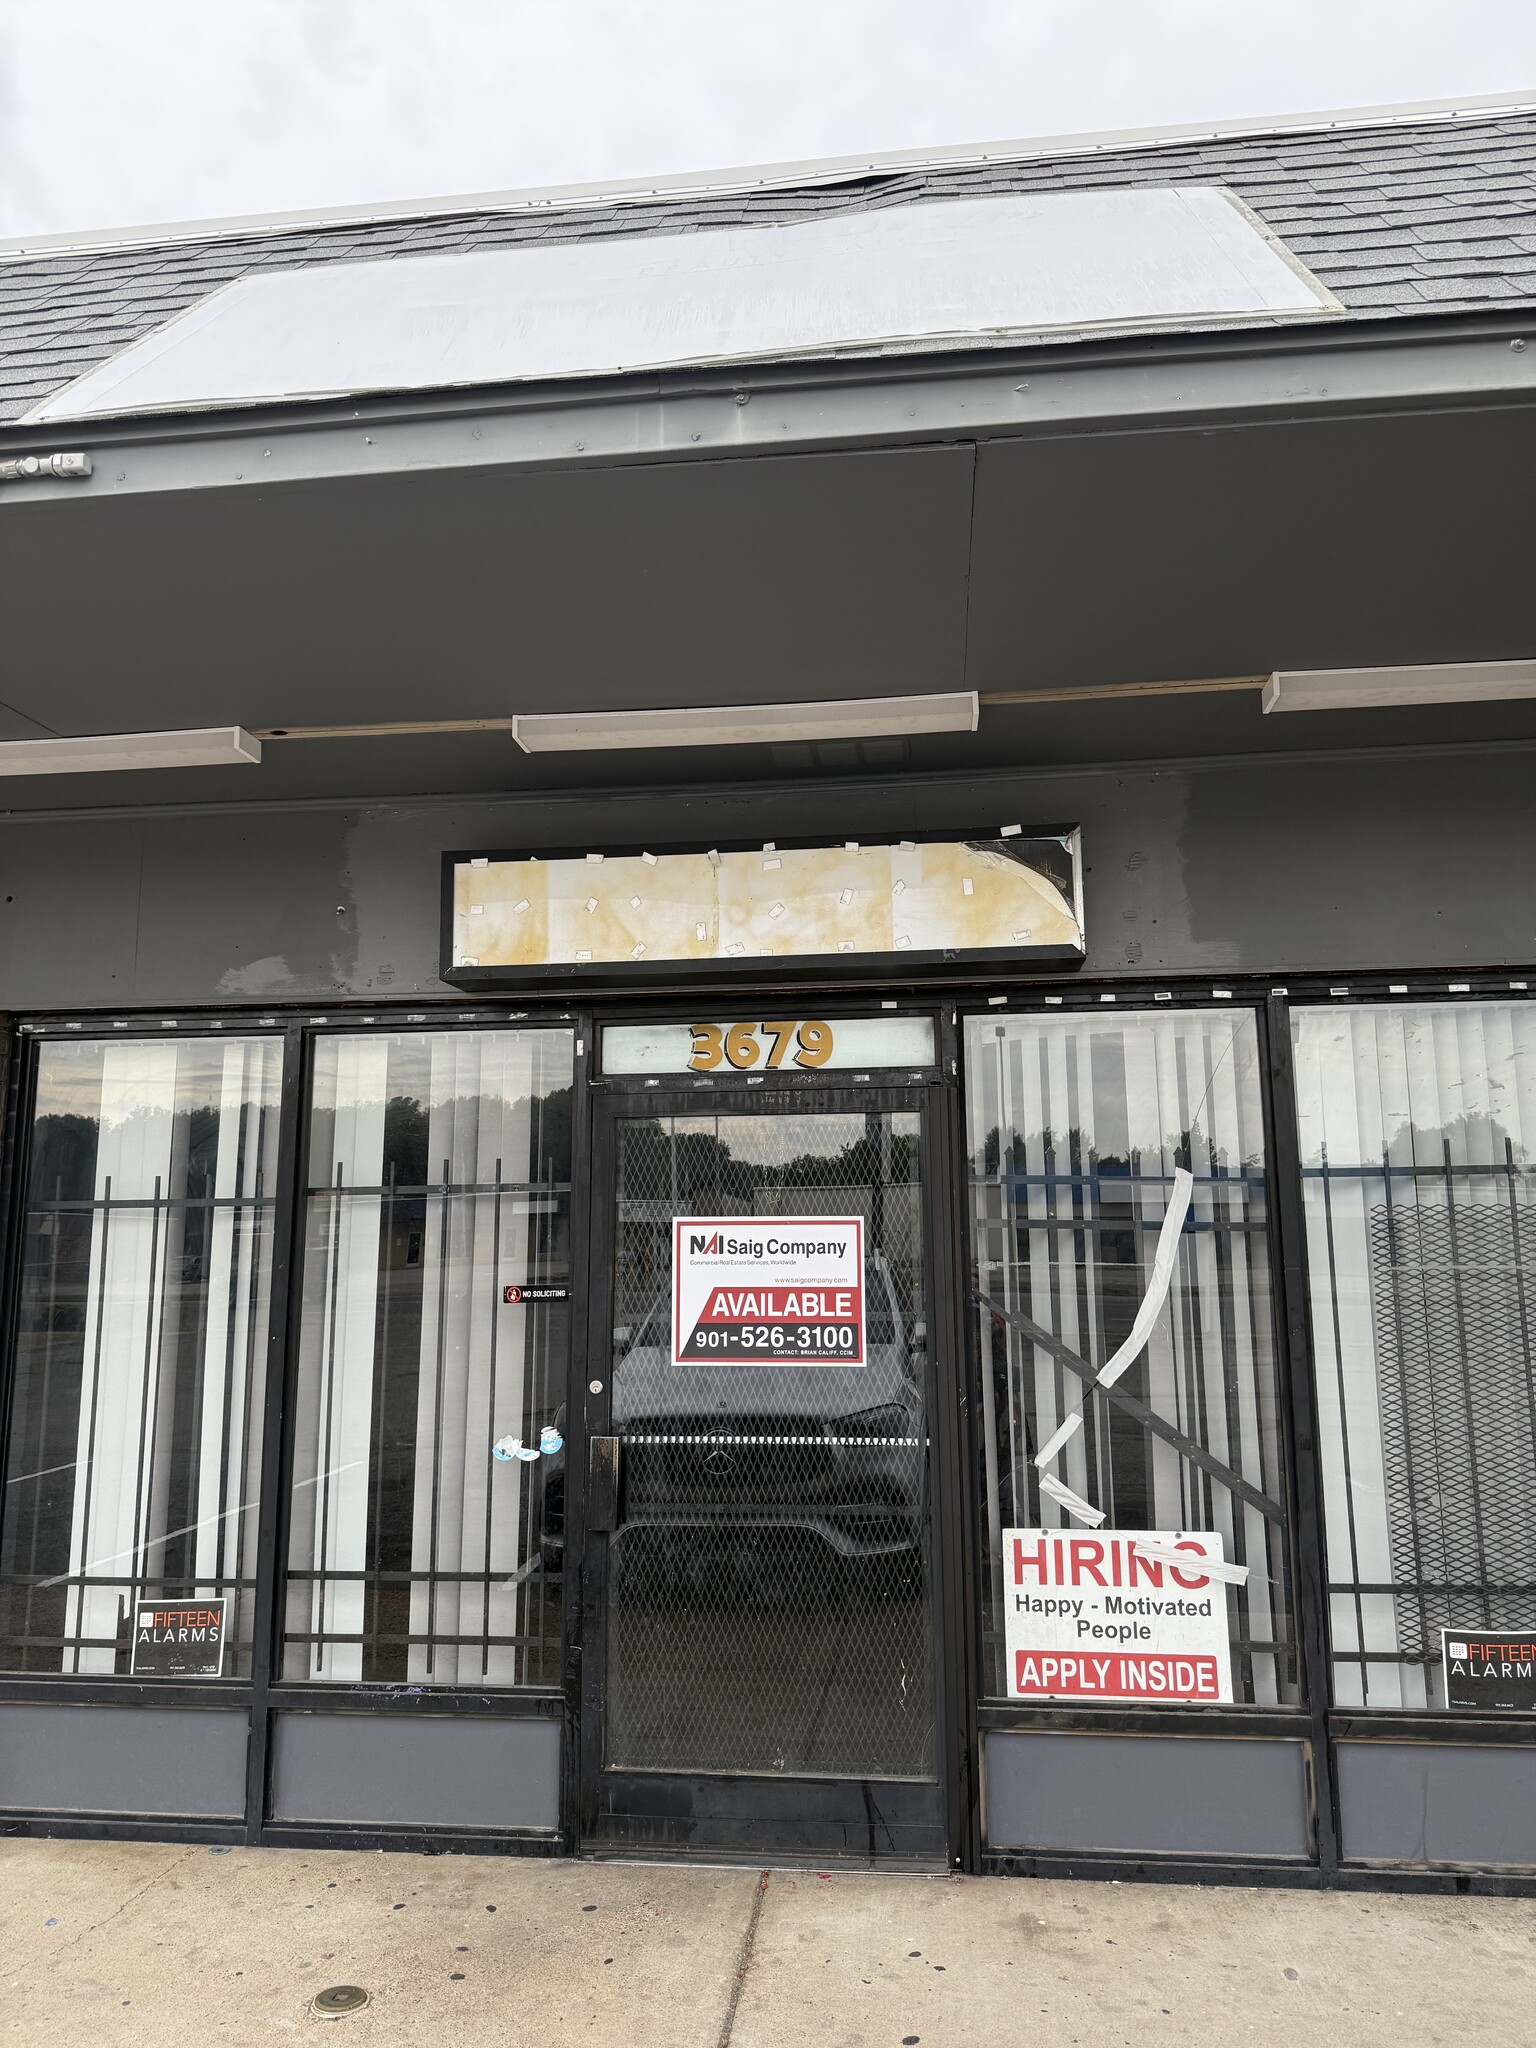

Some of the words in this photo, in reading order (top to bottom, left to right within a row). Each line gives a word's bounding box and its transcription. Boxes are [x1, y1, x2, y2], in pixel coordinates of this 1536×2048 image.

[687, 1020, 834, 1072] 3679
[690, 1231, 724, 1255] NAI
[727, 1238, 764, 1258] Saig
[767, 1238, 847, 1258] Company
[747, 1259, 770, 1267] Services,
[774, 1276, 848, 1285] www.saigcompany.com
[711, 1292, 852, 1317] AVAILABLE
[696, 1325, 853, 1349] 901-526-3100
[1015, 1594, 1083, 1618] Happy
[1105, 1596, 1212, 1617] Motivated
[154, 1609, 221, 1628] FIFTEEN
[138, 1626, 219, 1643] ALARMS
[1077, 1620, 1152, 1643] People
[1020, 1657, 1112, 1690] APPLY
[1120, 1659, 1216, 1693] INSIDE
